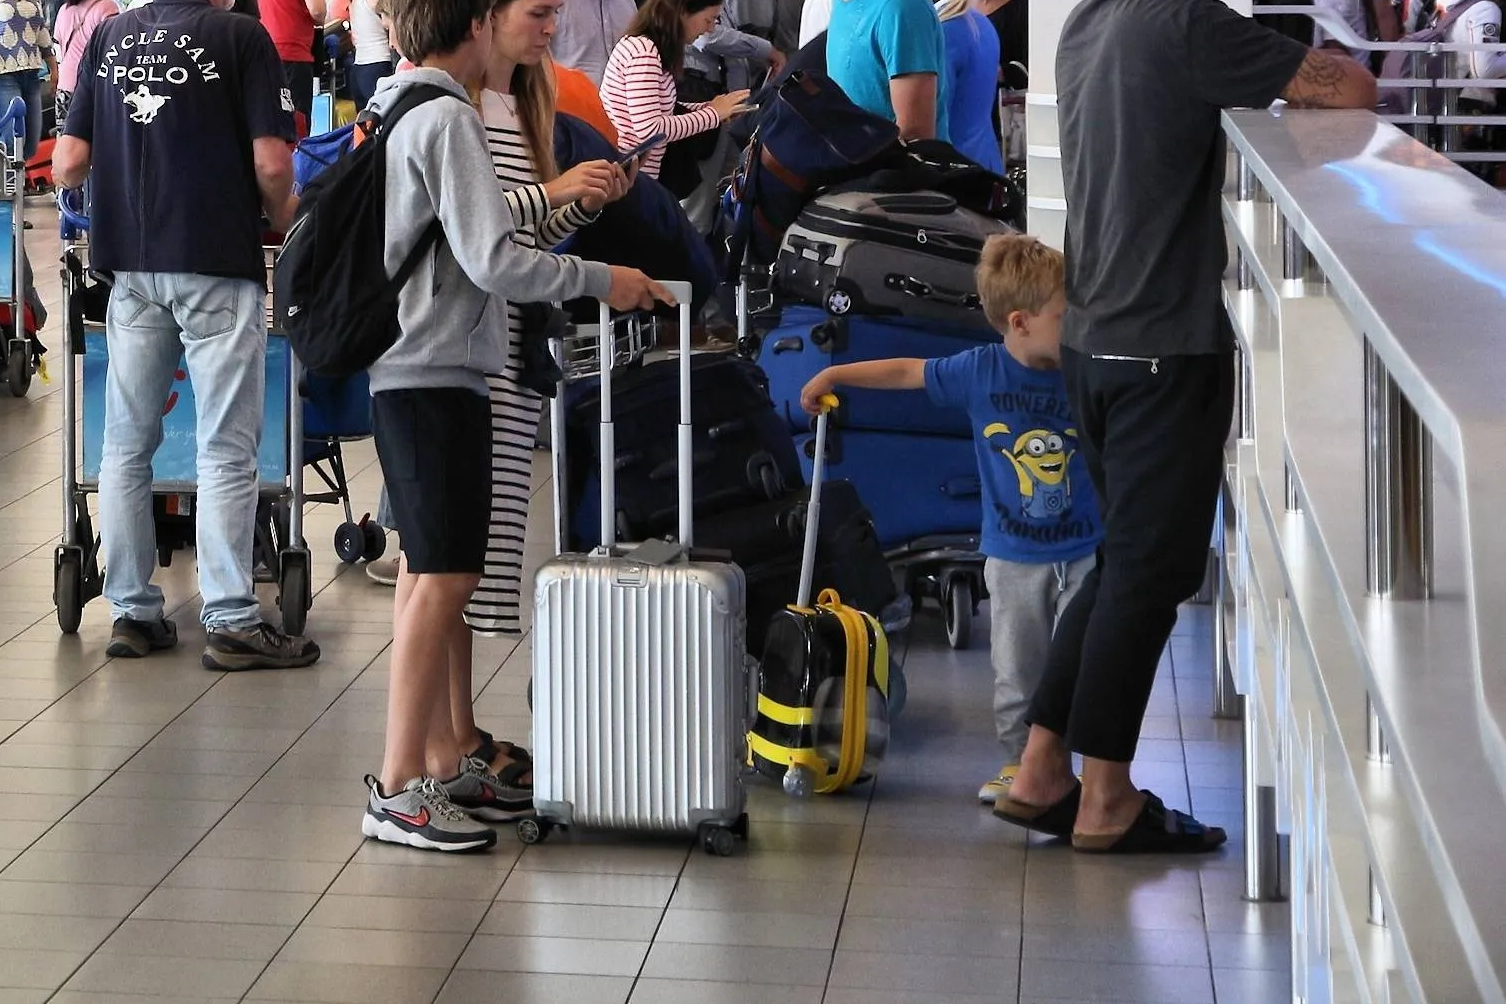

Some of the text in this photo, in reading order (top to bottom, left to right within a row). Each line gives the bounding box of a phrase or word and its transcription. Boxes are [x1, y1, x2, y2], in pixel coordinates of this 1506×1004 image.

[96, 29, 221, 83] UNCLE SAM
[135, 54, 167, 65] TEAM
[112, 65, 189, 85] POLO
[990, 392, 1073, 422] POWERE
